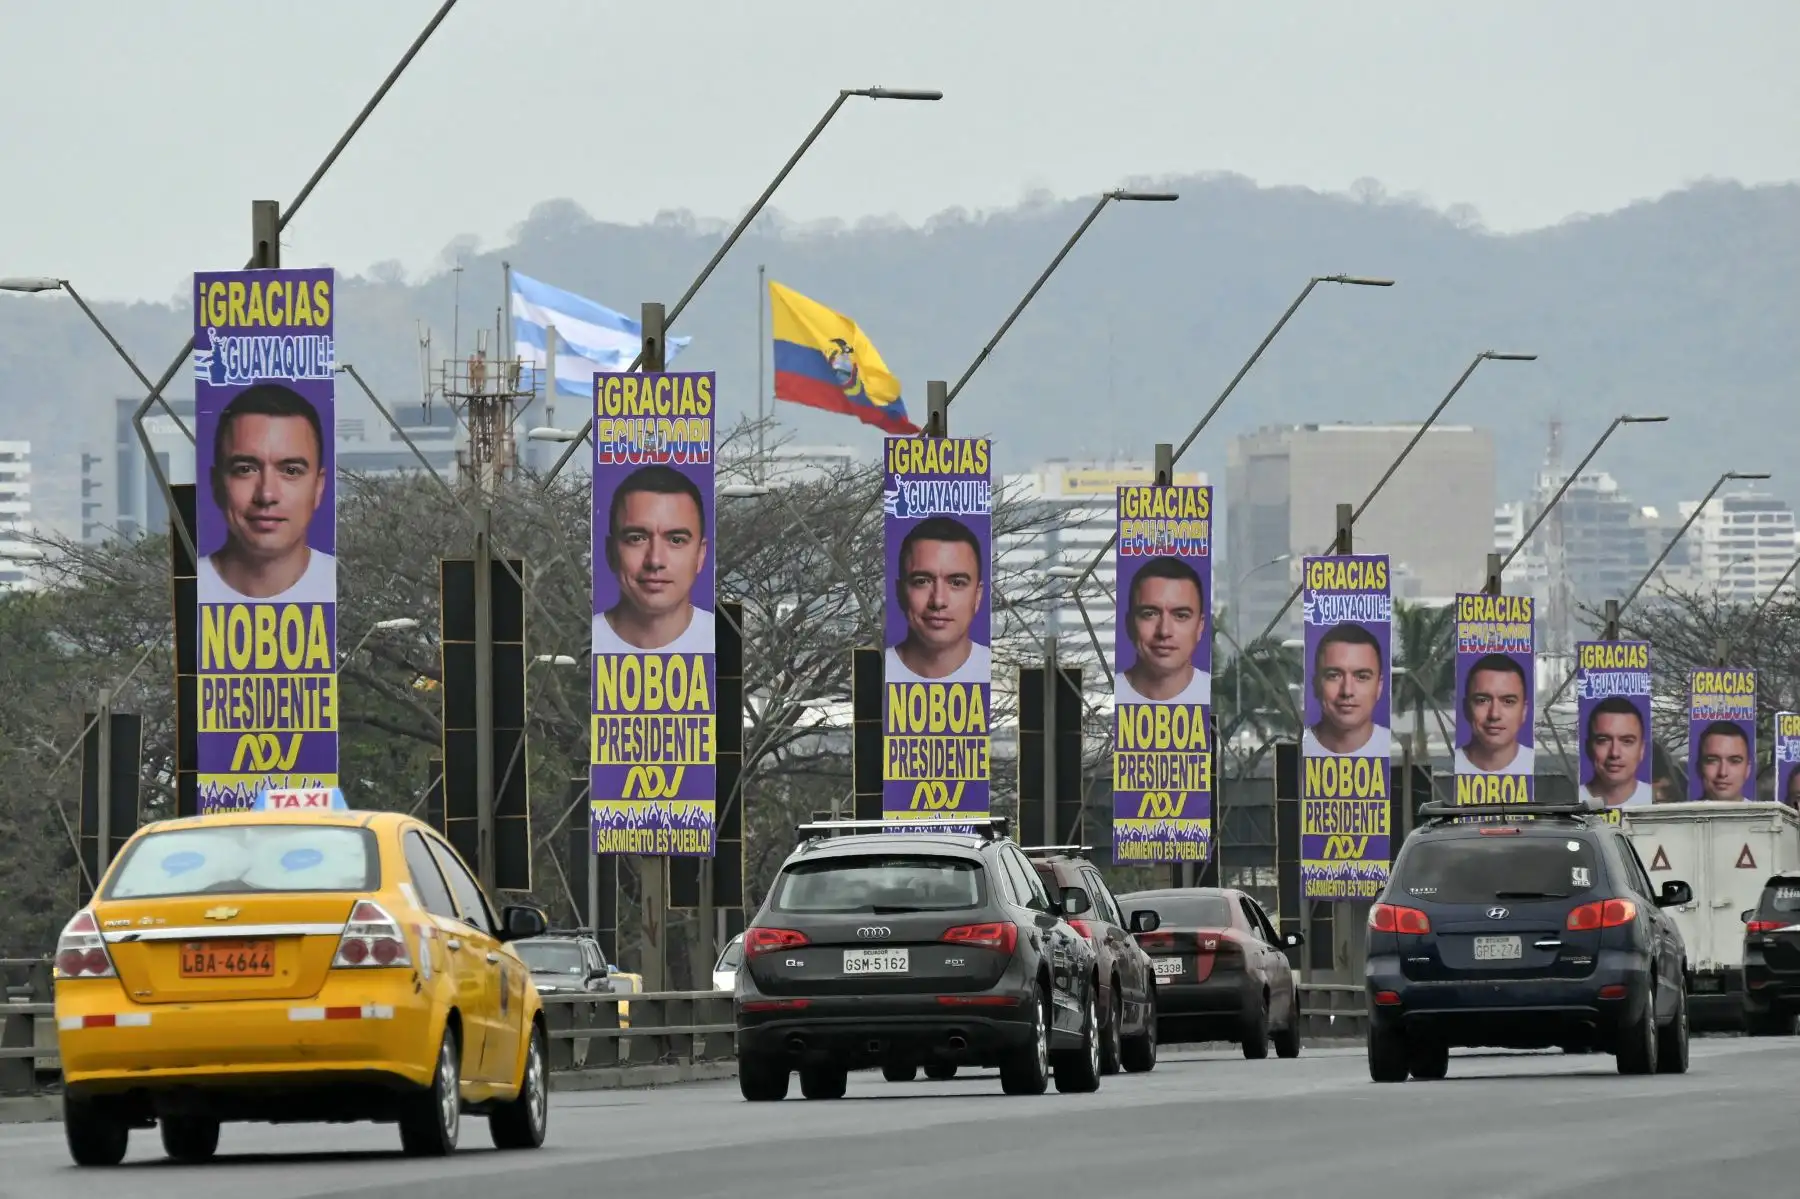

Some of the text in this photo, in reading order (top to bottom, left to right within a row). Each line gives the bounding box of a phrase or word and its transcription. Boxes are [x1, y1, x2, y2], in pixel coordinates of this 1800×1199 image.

[200, 280, 330, 327] ¡GRACIAS
[226, 335, 330, 380] GUAYAQUIL!
[597, 376, 711, 416] ¡GRACIAS
[598, 418, 711, 464] ECUADOR!
[888, 438, 988, 474] ¡GRACIAS
[908, 480, 988, 514] GUAYAQUIL!
[1120, 487, 1210, 518] ¡GRACIAS
[1120, 519, 1208, 556] ECUADOR!
[1306, 561, 1387, 590] ¡GRACIAS
[1322, 594, 1387, 622] GUAYAQUIL!
[1458, 596, 1532, 622] ¡GRACIAS
[201, 604, 331, 670] NOBOA
[1458, 622, 1531, 653] ECUADOR!
[1580, 645, 1648, 669] ¡GRACIAS
[596, 654, 710, 711] NOBOA
[1692, 671, 1755, 693] ¡GRACIAS
[202, 677, 331, 729] PRESIDENTE
[888, 683, 986, 733] NOBOA
[597, 717, 709, 762] PRESIDENTE
[1118, 704, 1206, 749] NOBOA
[889, 738, 986, 778] PRESIDENTE
[1118, 754, 1206, 789] PRESIDENTE
[1305, 757, 1386, 797] NOBOA
[1457, 774, 1529, 805] NOBOA
[270, 792, 328, 809] TAXI
[1306, 802, 1386, 833] PRESIDENTE
[597, 828, 711, 853] ¡SARMIENTO ES PUEBLO!
[1118, 841, 1207, 860] ¡SARMIENTO ES PUEBLO!
[1347, 880, 1357, 897] ES
[182, 952, 271, 973] LBA-4644
[845, 957, 907, 971] GSM-5162
